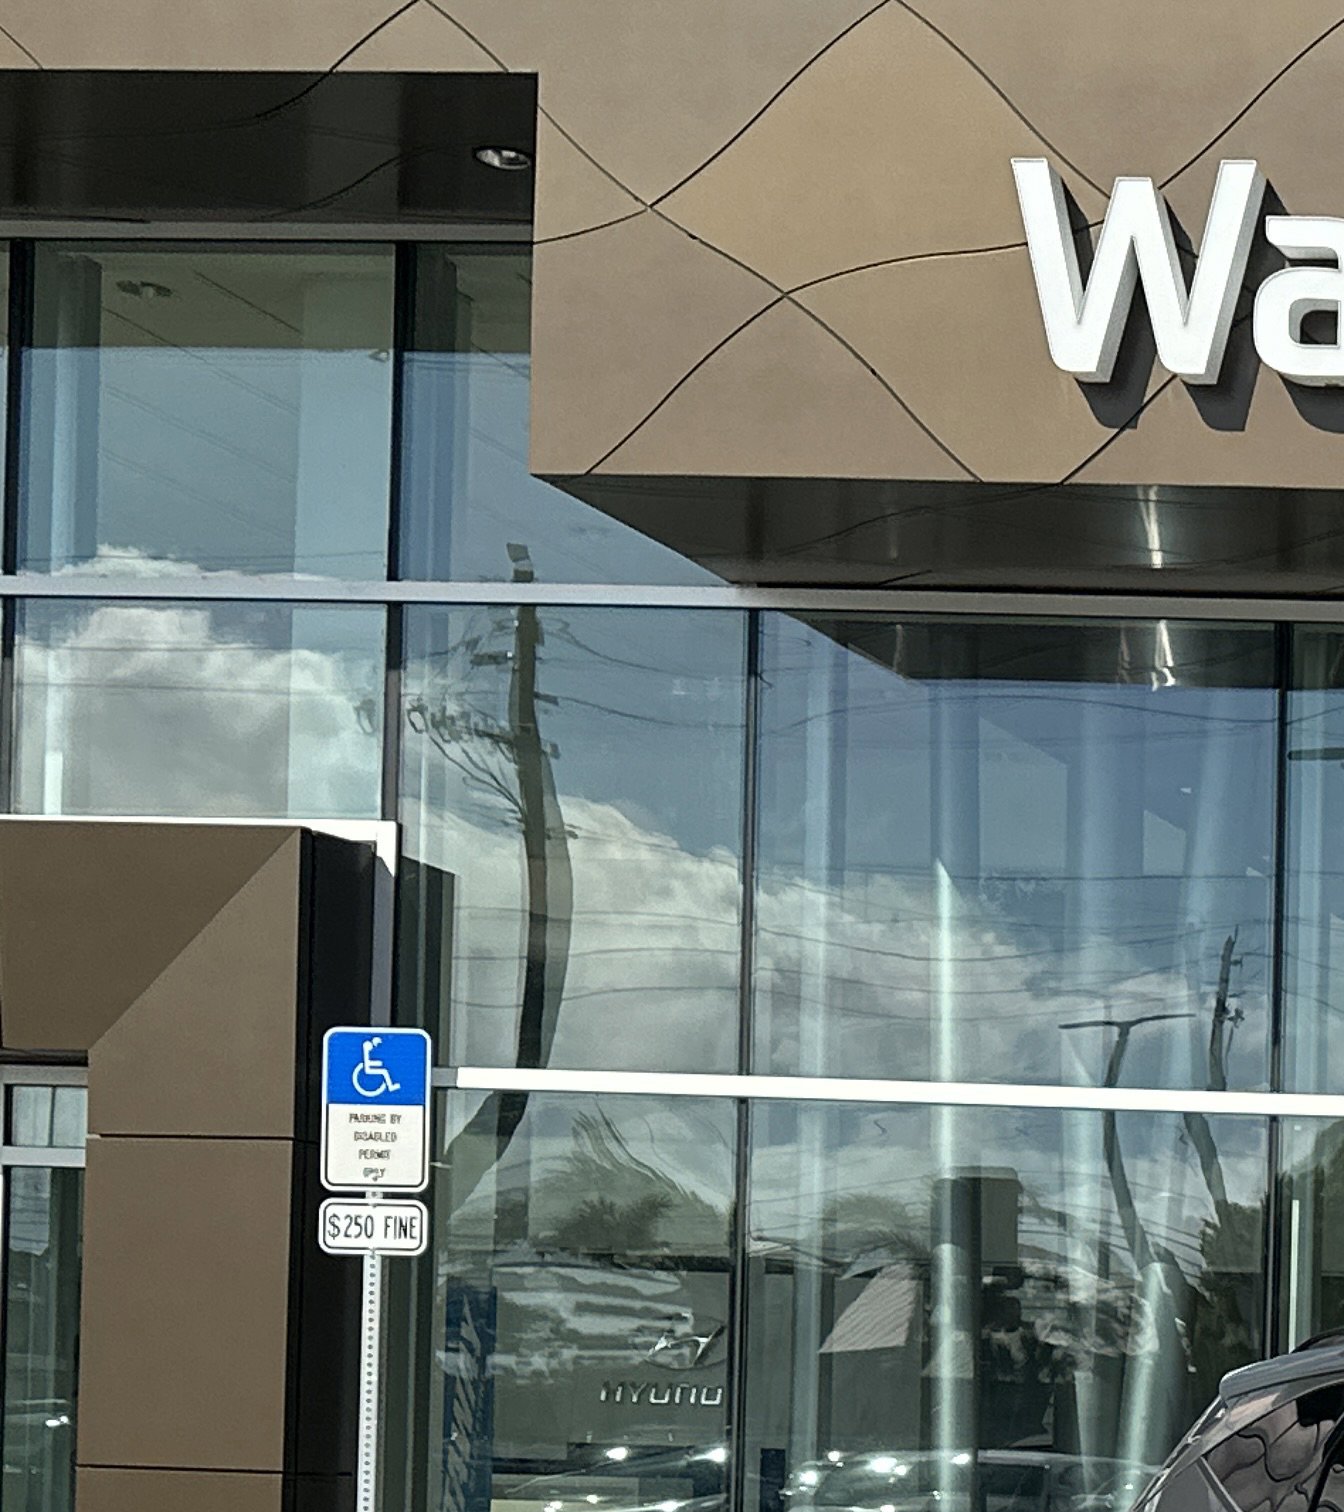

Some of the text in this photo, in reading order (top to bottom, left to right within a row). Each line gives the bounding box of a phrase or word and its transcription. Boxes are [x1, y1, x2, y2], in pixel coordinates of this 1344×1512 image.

[349, 1113, 402, 1124] PARKING BY
[354, 1131, 398, 1142] DISABLED
[327, 1213, 418, 1241] $250 FINE
[600, 1381, 723, 1405] HYUND
